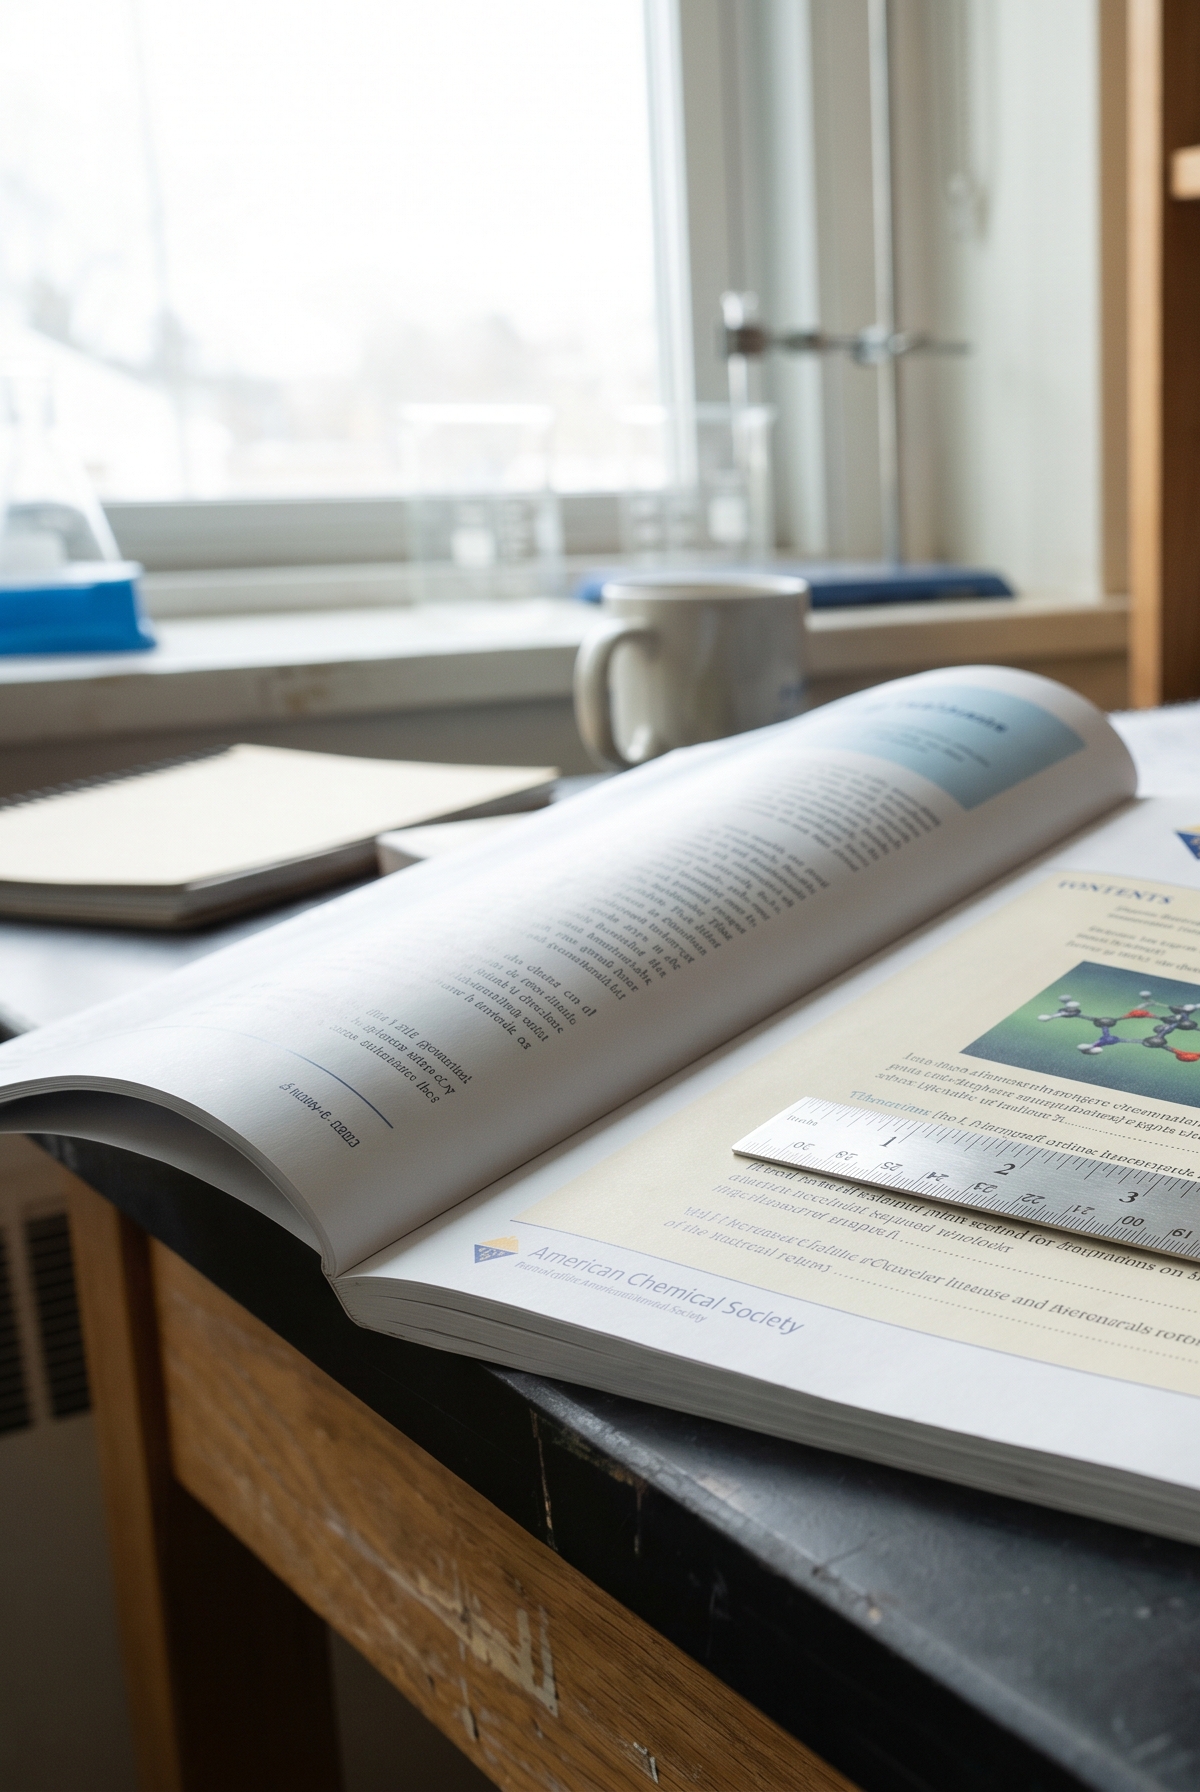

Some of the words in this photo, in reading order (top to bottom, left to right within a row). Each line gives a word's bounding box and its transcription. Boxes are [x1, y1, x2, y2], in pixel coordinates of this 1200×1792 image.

[879, 1136, 897, 1148] 1
[993, 1163, 1016, 1176] 2
[1118, 1191, 1139, 1204] 3
[1020, 1193, 1045, 1205] 22
[527, 1246, 626, 1282] American
[627, 1271, 726, 1310] Chemical
[1028, 1233, 1055, 1247] for
[1159, 1266, 1184, 1279] on
[1015, 1293, 1049, 1311] and
